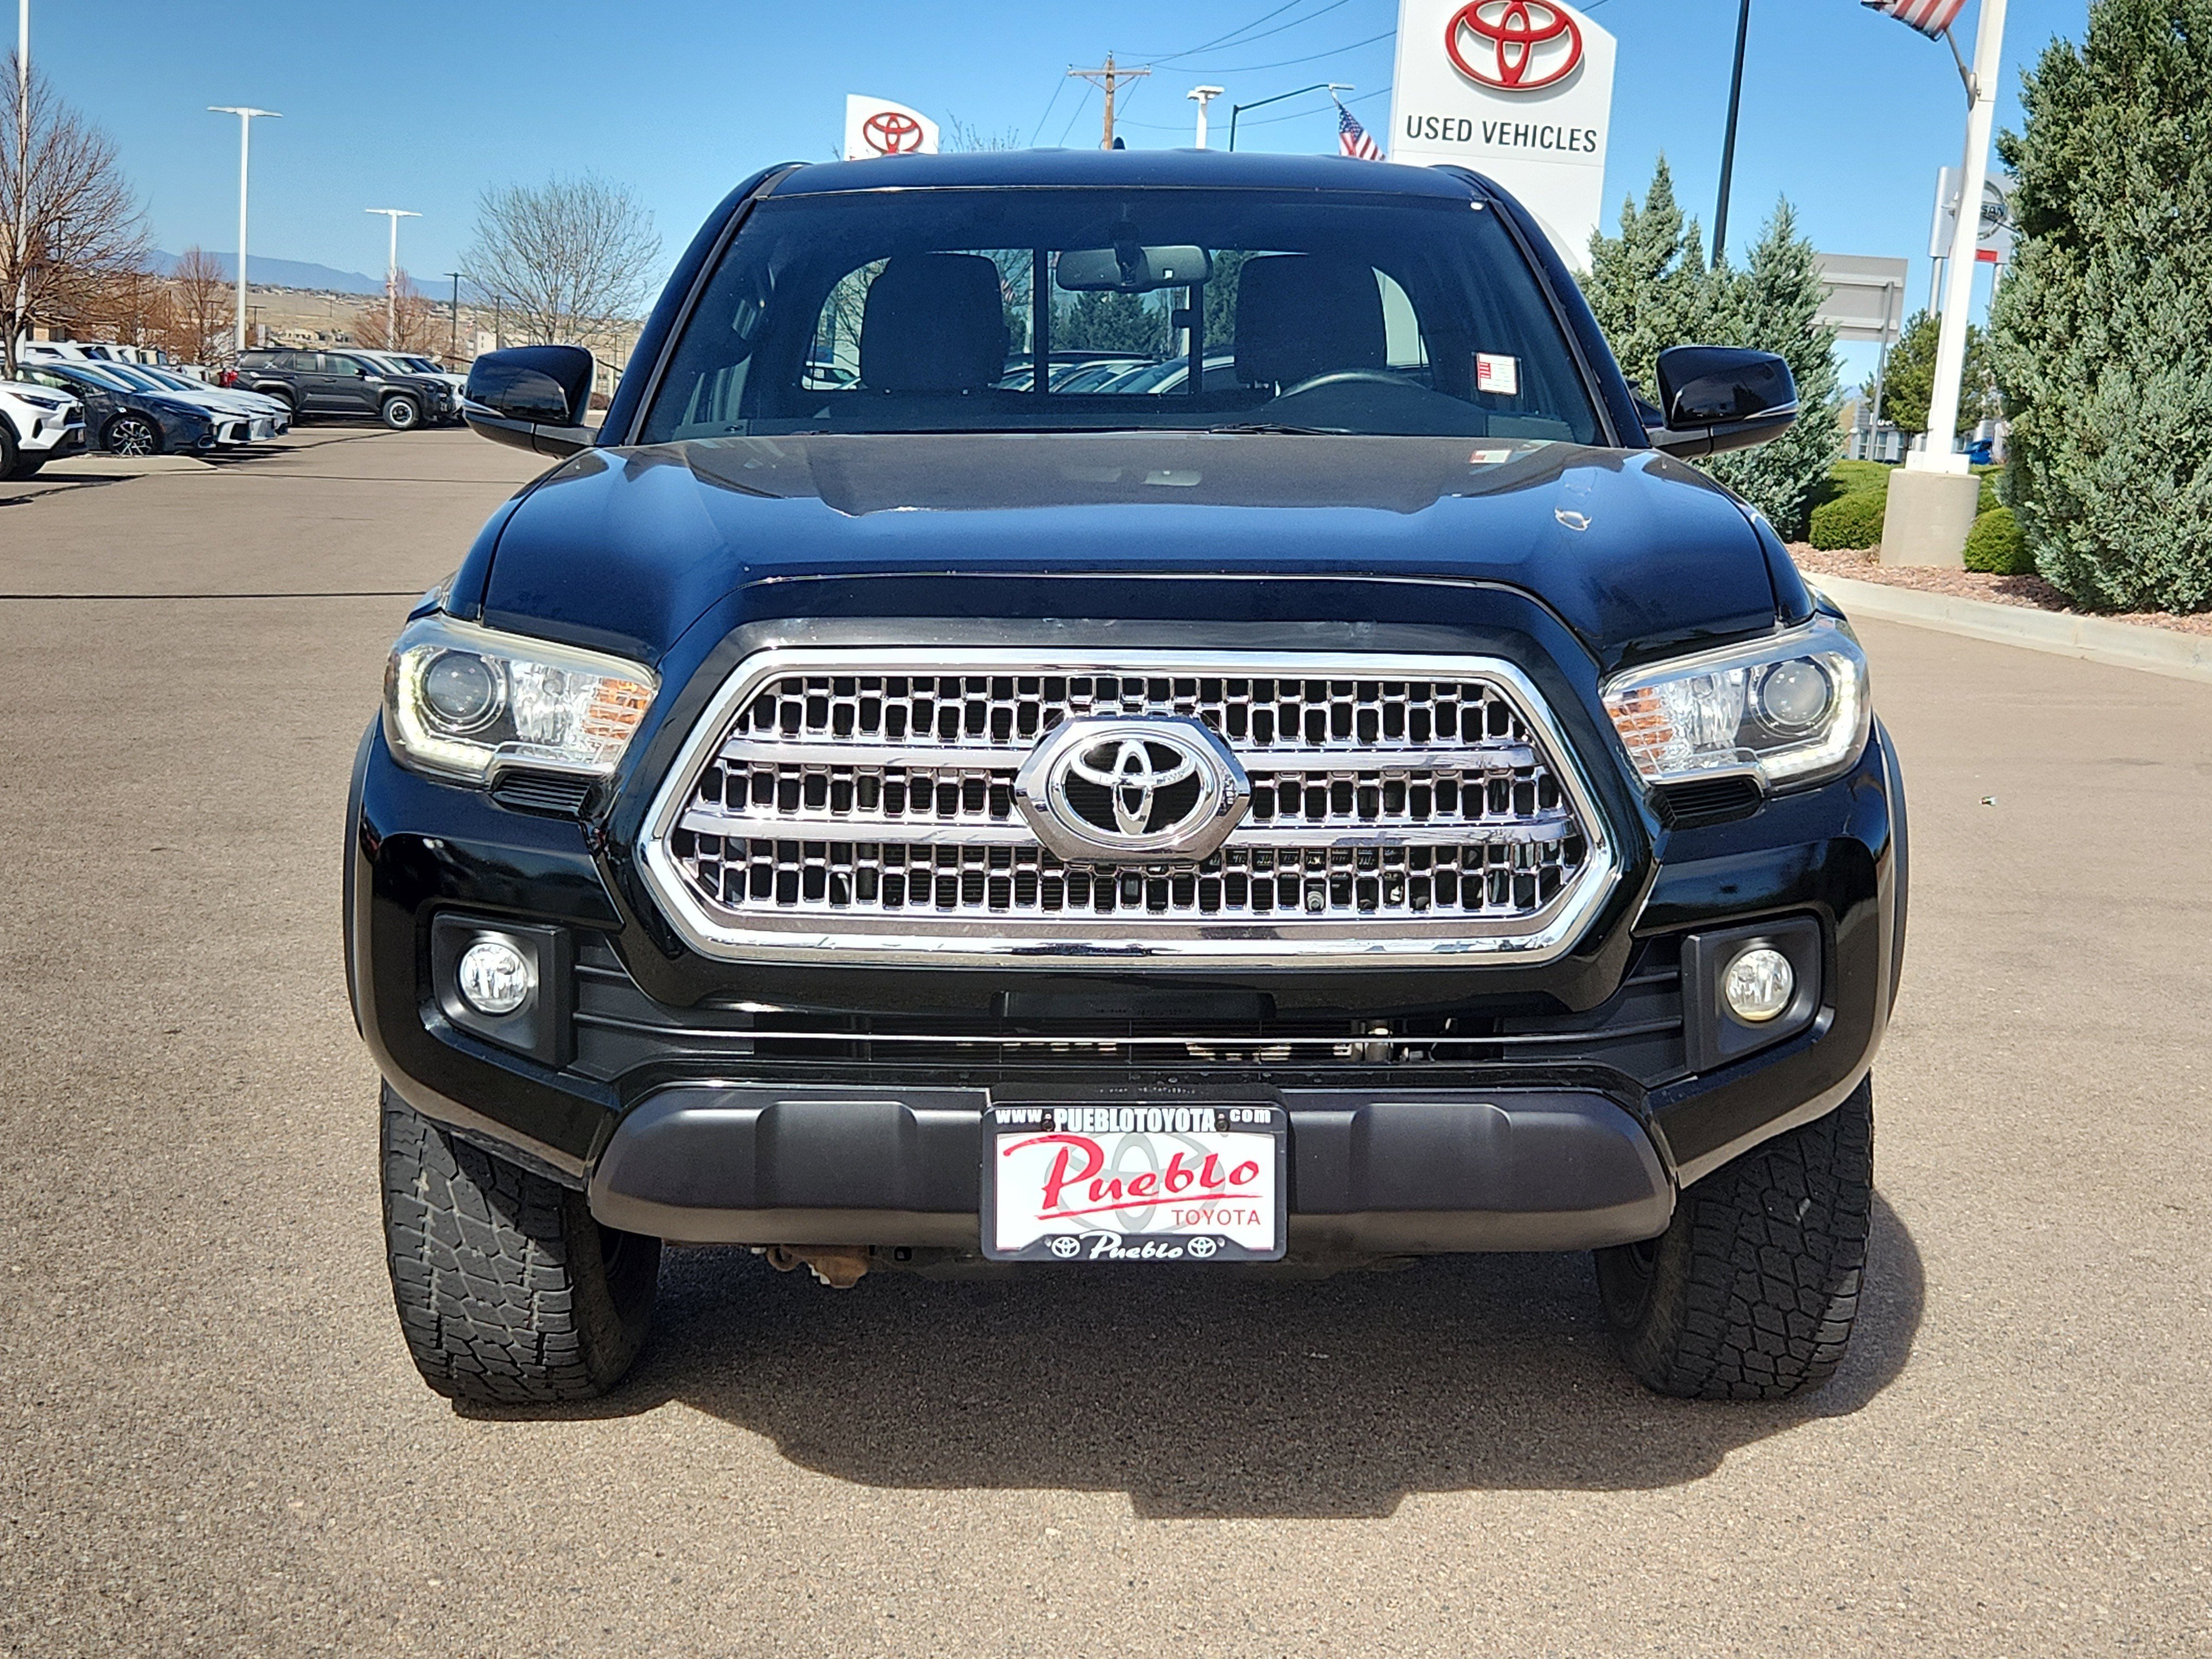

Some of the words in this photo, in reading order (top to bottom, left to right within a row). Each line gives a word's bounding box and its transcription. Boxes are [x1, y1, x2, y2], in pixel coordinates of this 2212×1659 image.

[1406, 115, 1472, 142] USED
[1482, 121, 1597, 152] VEHICLES
[1003, 1135, 1259, 1210] Pueblo
[1172, 1209, 1261, 1225] TOYOTA
[1079, 1230, 1184, 1259] Pueblo
